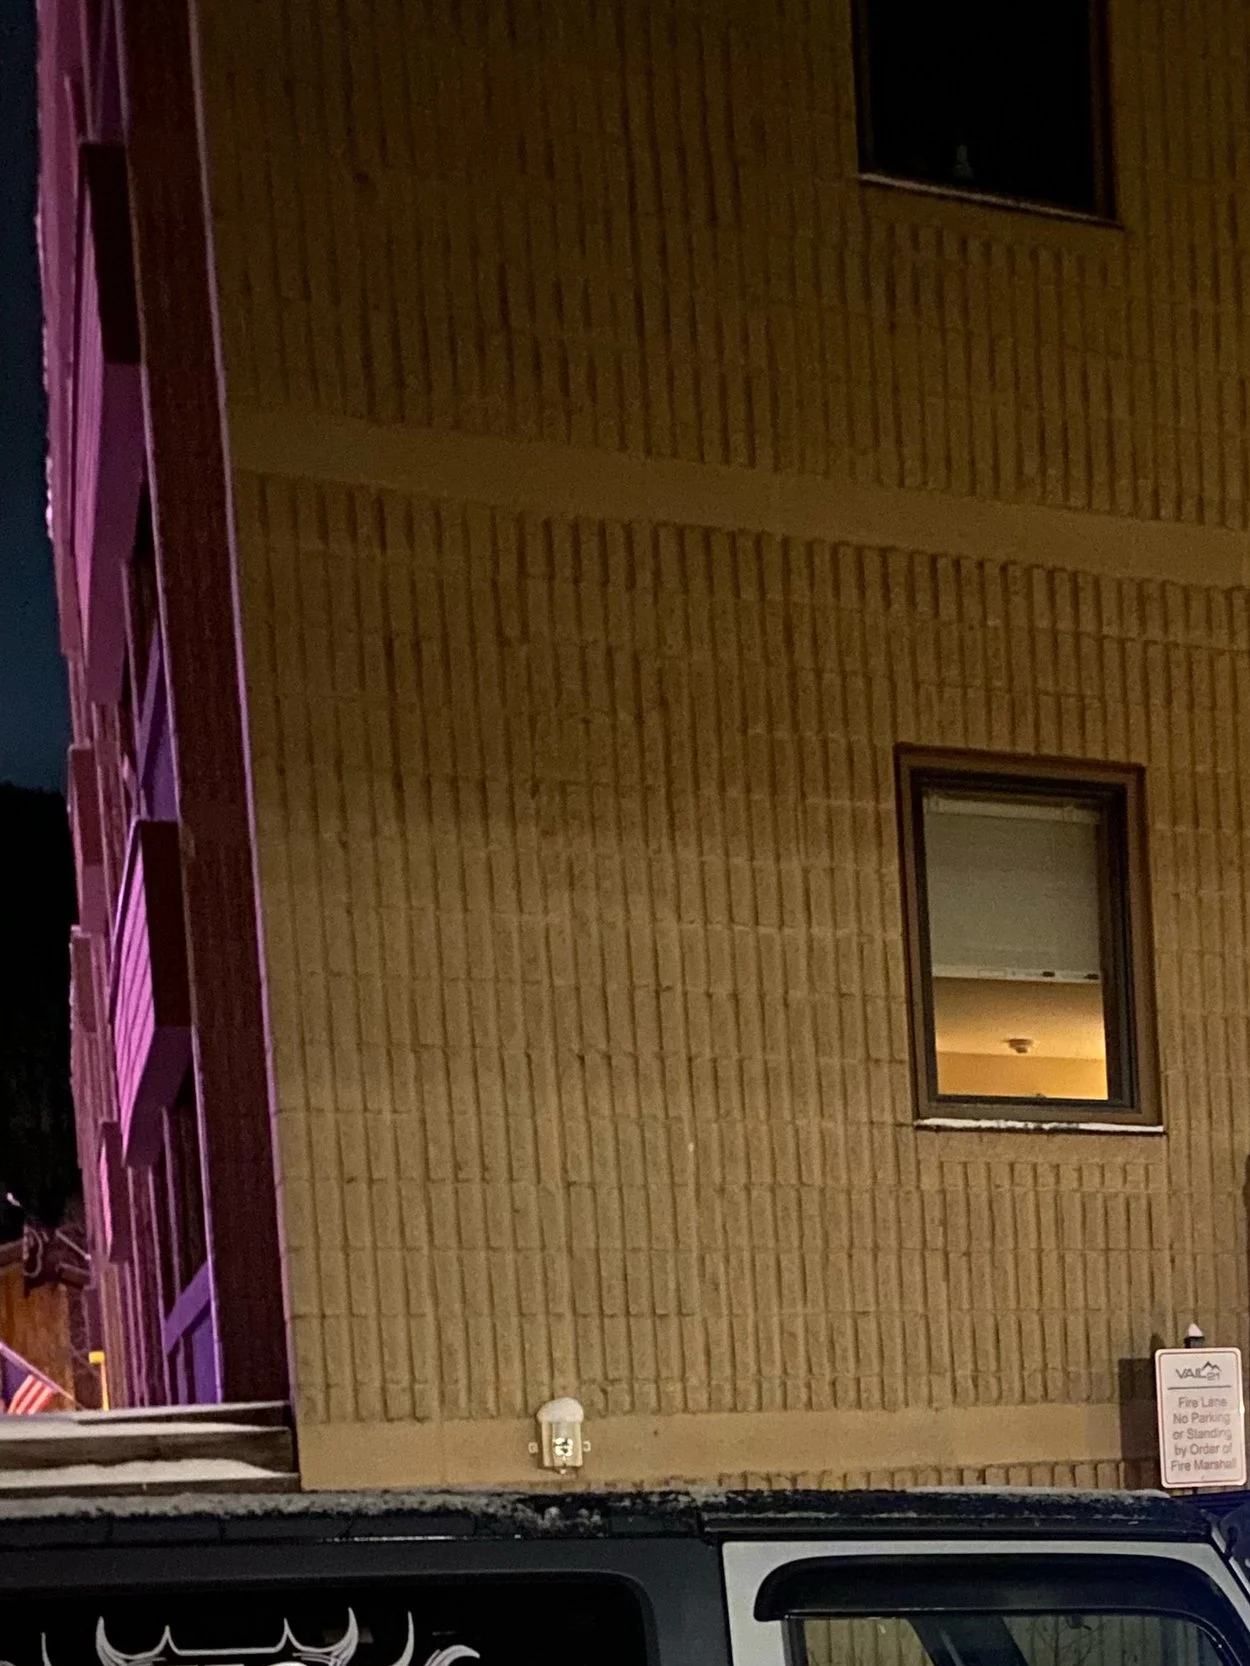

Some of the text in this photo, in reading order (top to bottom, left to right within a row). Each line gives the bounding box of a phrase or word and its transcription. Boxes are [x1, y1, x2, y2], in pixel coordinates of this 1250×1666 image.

[1176, 1368, 1220, 1381] VAIL 21
[1178, 1396, 1228, 1408] Fire Lane
[1173, 1412, 1231, 1426] No Parking
[1172, 1428, 1233, 1442] or Standing
[1174, 1443, 1233, 1458] by Order of
[1171, 1460, 1192, 1472] Fire
